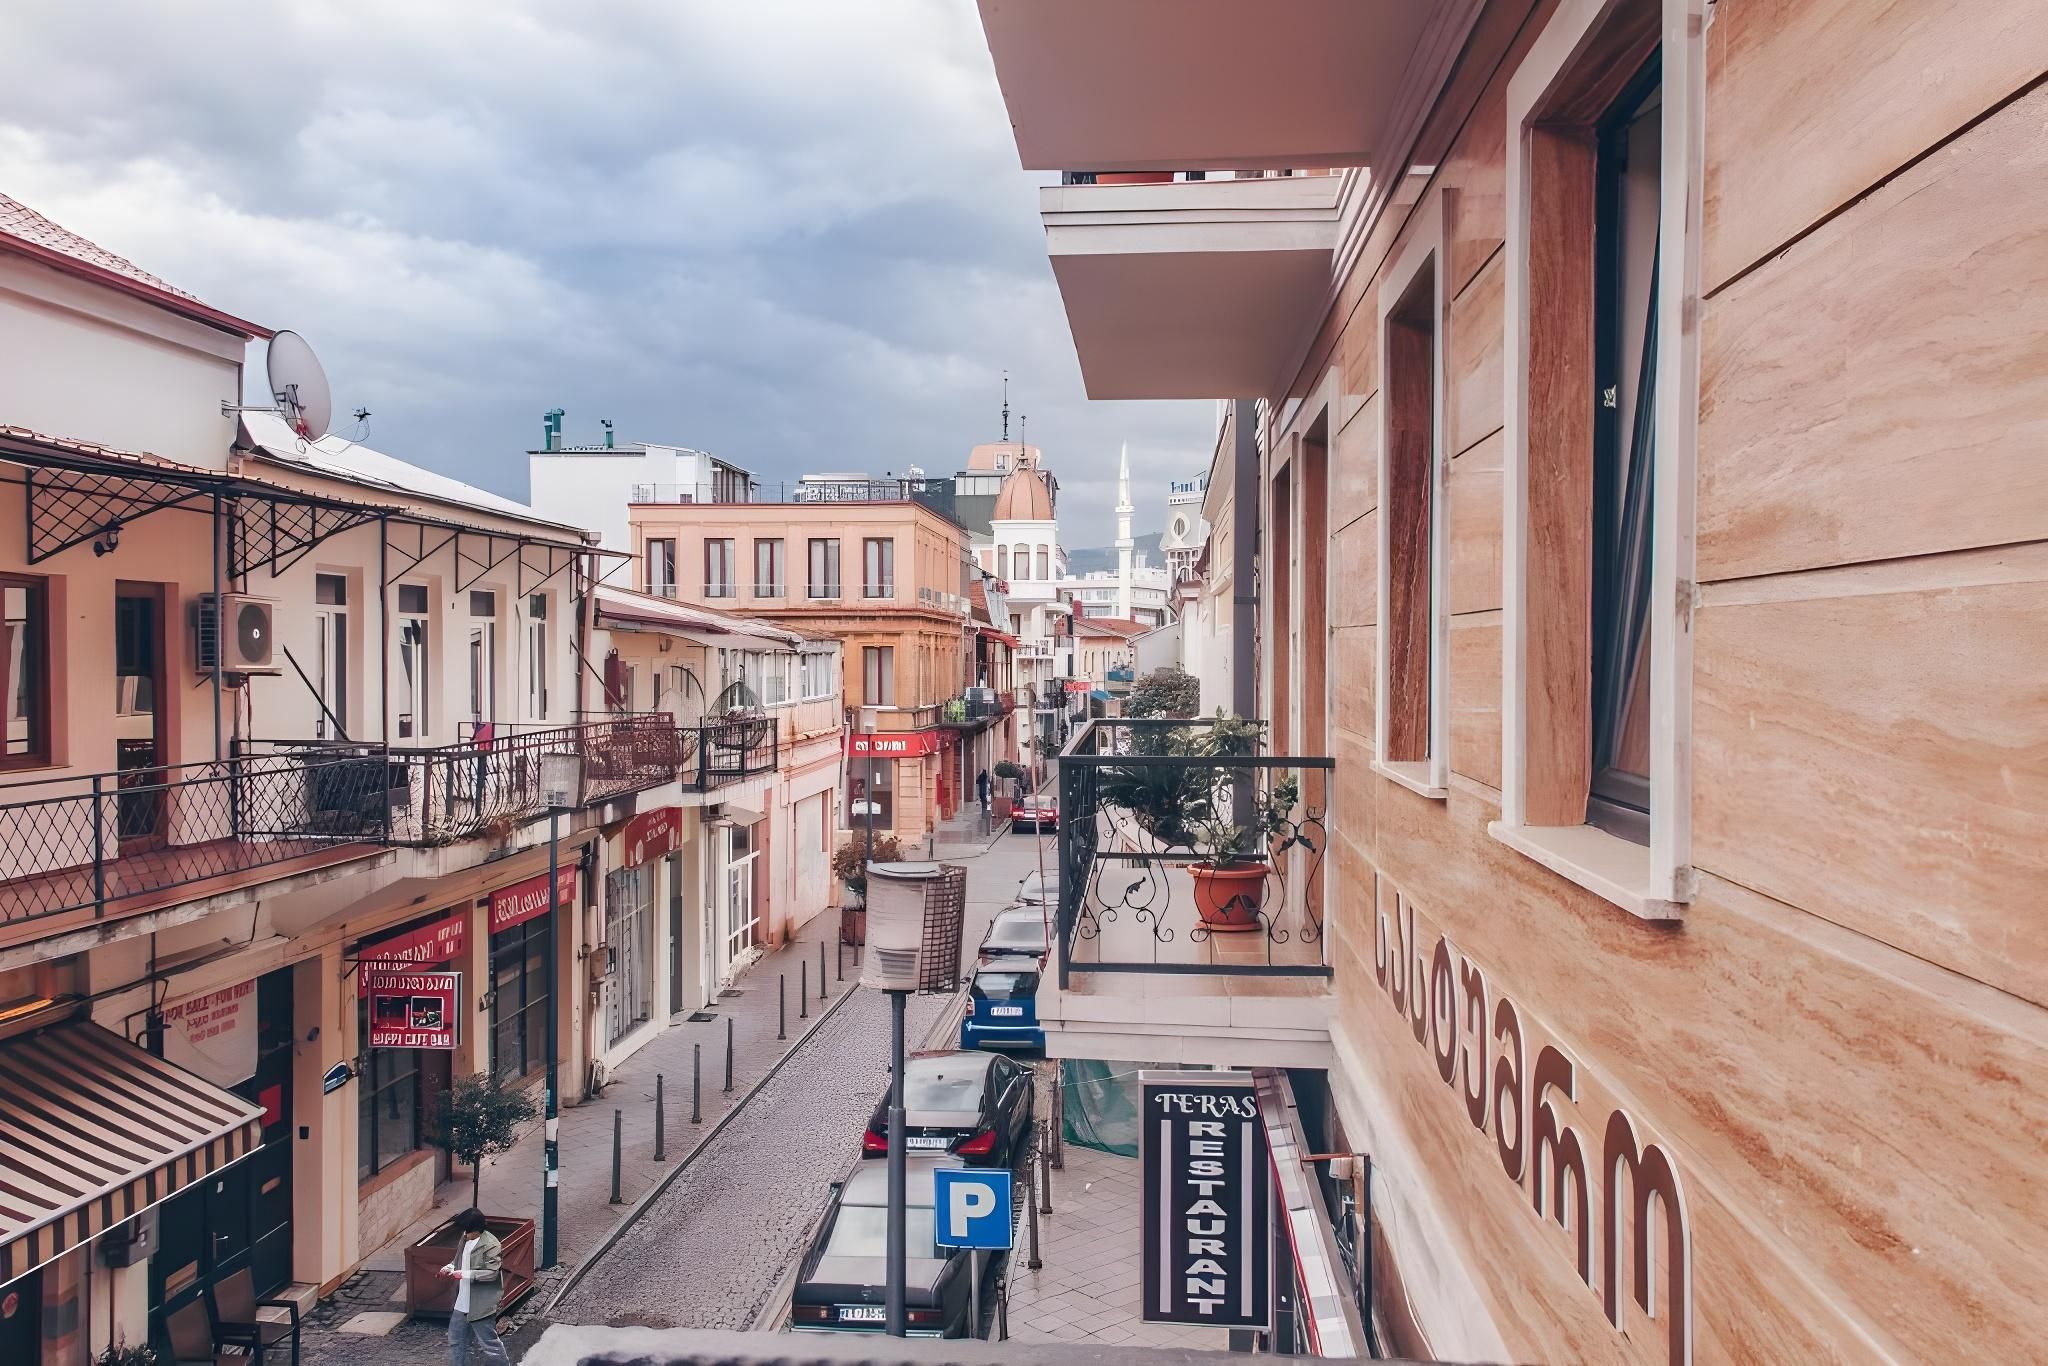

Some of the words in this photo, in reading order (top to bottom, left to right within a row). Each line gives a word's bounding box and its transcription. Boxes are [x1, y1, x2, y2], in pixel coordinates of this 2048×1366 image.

[1155, 1093, 1257, 1118] TERAS
[949, 1181, 996, 1238] P
[1185, 1120, 1228, 1315] RESTAURANT
